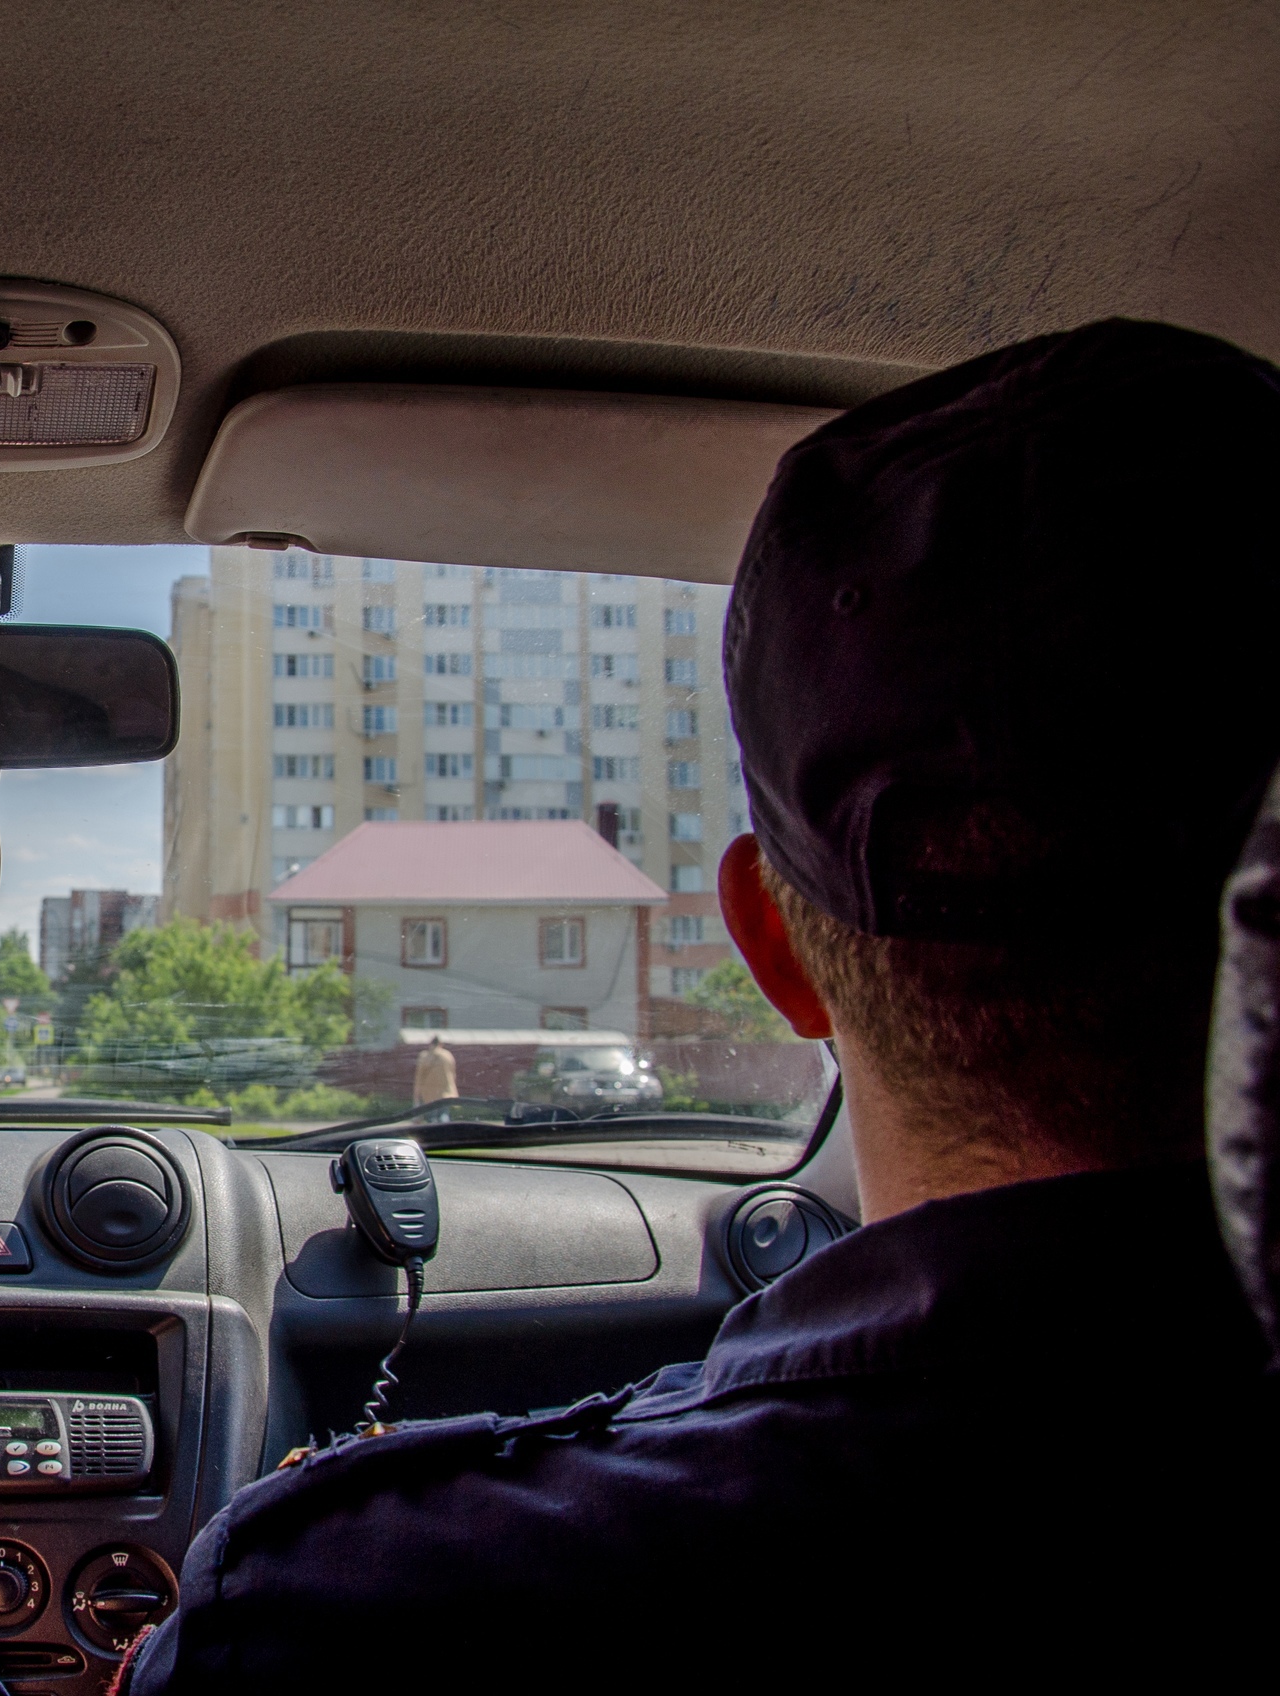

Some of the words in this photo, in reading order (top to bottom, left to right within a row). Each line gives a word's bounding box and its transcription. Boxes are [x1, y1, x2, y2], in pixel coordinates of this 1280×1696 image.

[88, 1402, 127, 1411] ВОЛНА
[16, 1553, 21, 1562] 1
[27, 1565, 34, 1574] 2
[31, 1582, 39, 1591] 3
[27, 1598, 34, 1608] 4
